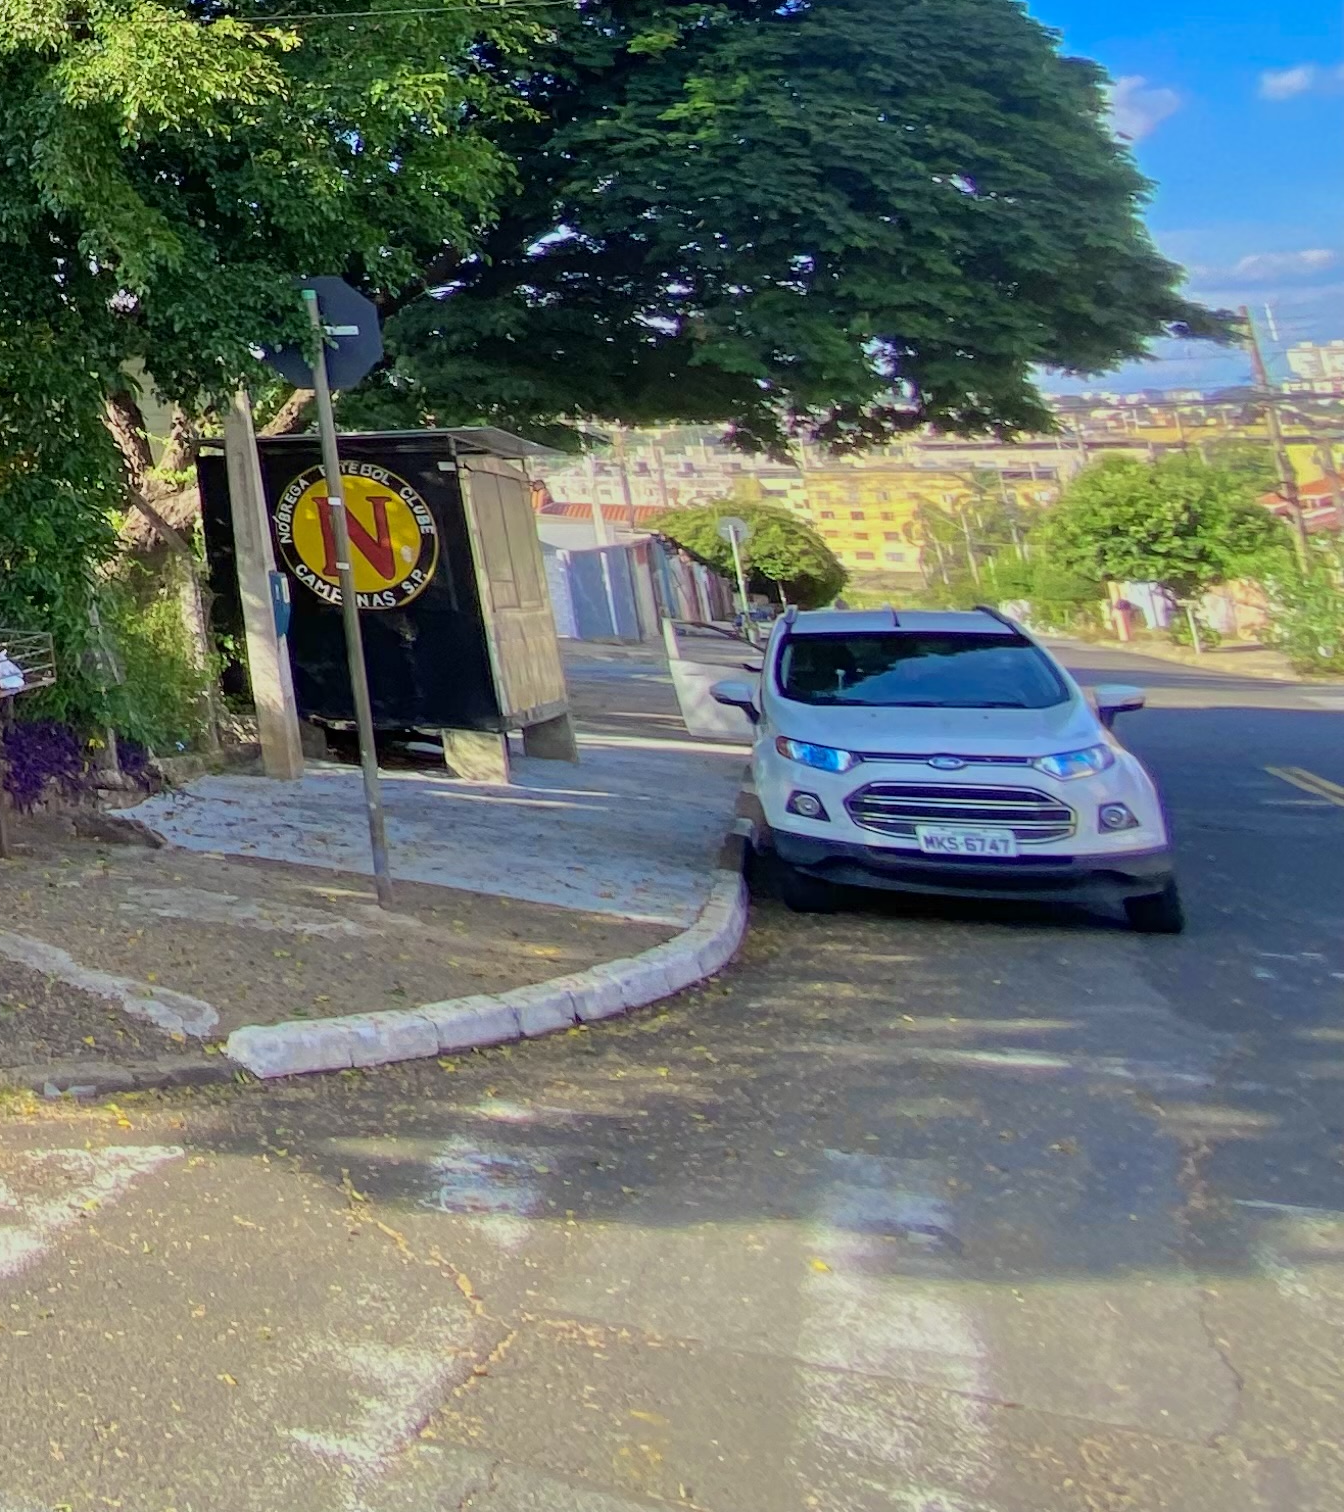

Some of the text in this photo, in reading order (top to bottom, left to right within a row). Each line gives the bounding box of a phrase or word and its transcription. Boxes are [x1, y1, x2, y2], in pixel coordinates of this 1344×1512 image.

[318, 461, 390, 486] FTEBOL
[399, 487, 435, 535] CLUBE
[311, 496, 397, 580] N
[295, 564, 397, 607] CAMPNAS
